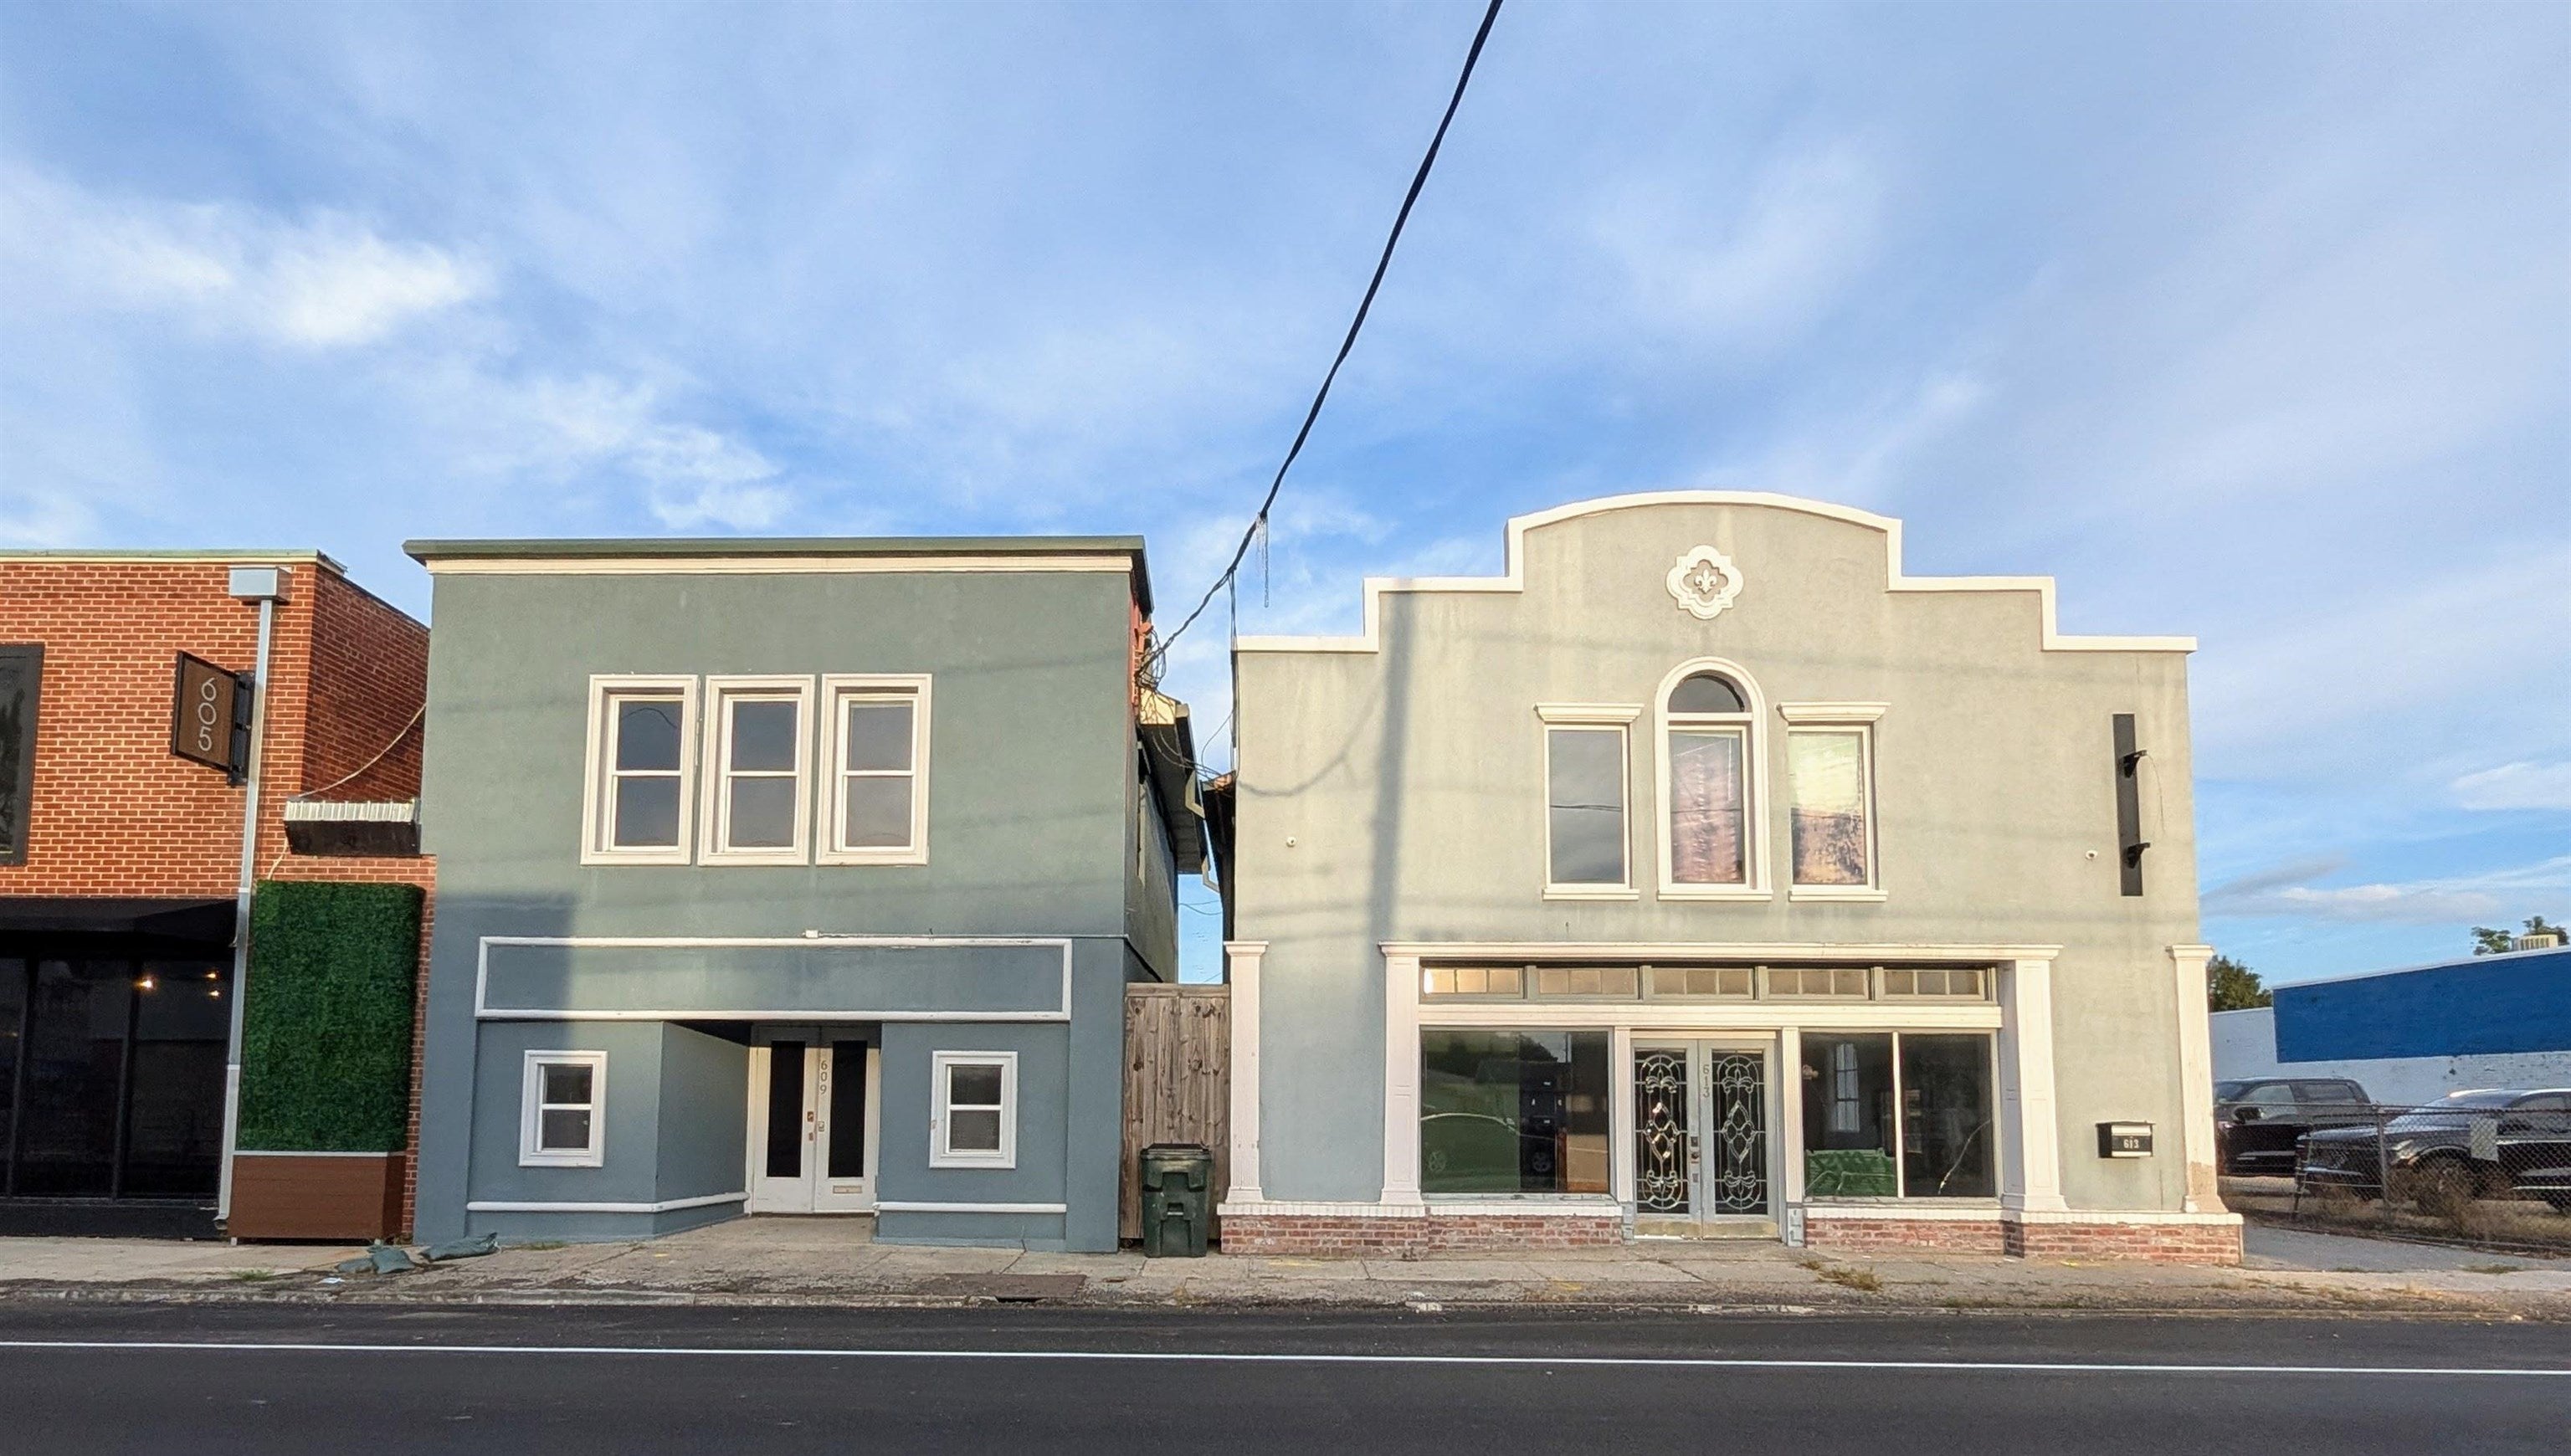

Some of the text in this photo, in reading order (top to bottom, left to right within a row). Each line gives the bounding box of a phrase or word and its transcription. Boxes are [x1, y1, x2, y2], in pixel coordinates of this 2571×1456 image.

[198, 676, 218, 752] 605
[819, 1059, 828, 1095] 609
[2123, 1138, 2139, 1149] 613
